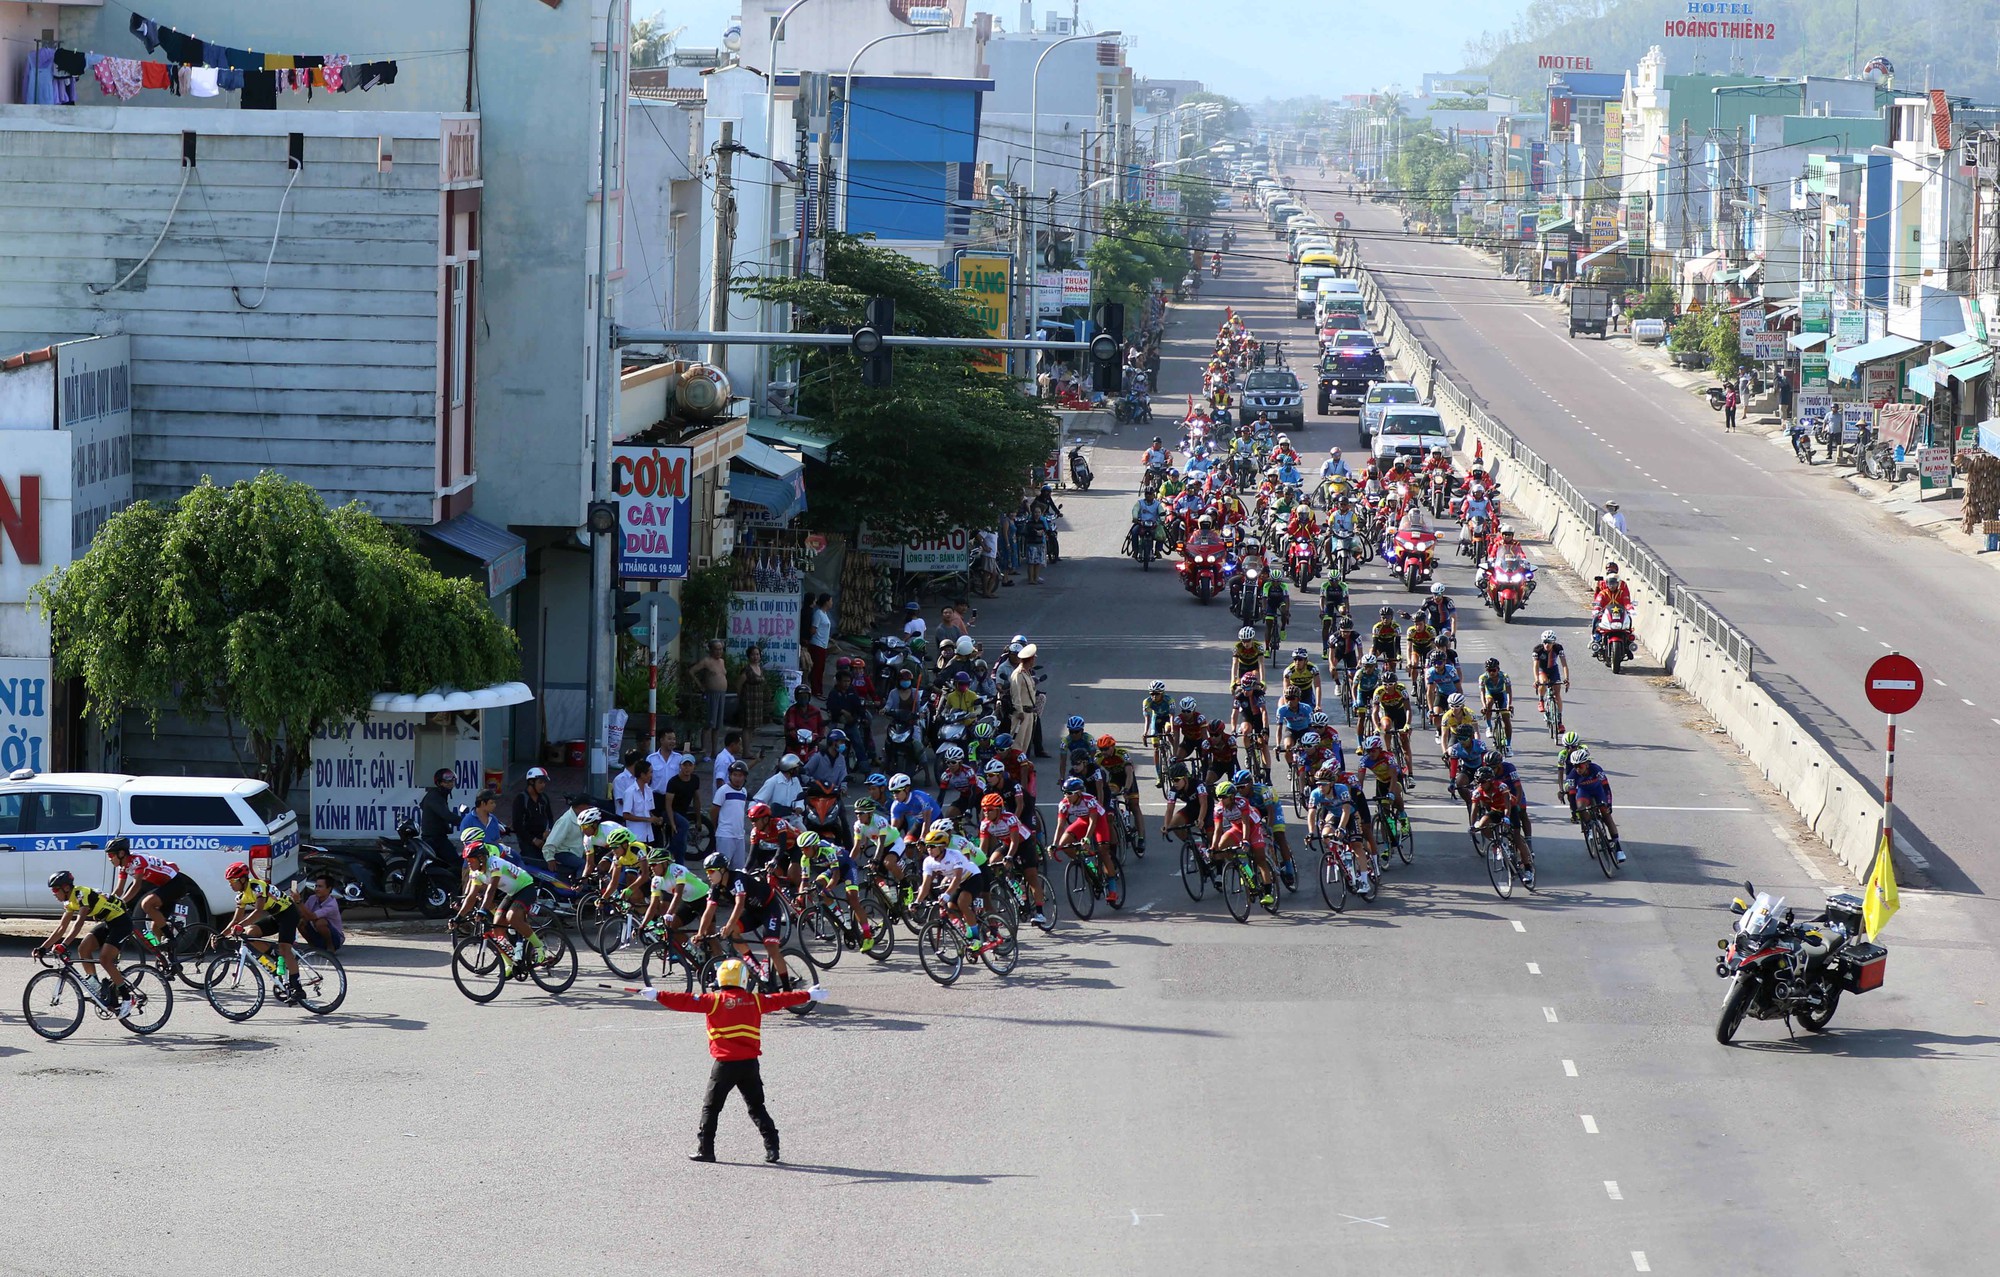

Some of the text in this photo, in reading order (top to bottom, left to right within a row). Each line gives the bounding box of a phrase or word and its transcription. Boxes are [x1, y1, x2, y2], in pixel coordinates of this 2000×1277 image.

[1688, 2, 1753, 14] HOTEL
[1665, 16, 1717, 37] HOÀNG
[1721, 18, 1763, 39] THIÊN
[1538, 55, 1593, 70] MOTEL
[963, 265, 1005, 294] XĂNG
[1741, 310, 1763, 319] HONDA
[1755, 342, 1770, 358] BÚN
[1870, 370, 1883, 379] THANH
[64, 357, 80, 425] MẮT
[80, 362, 96, 420] KÍNH
[615, 448, 687, 498] CƠM
[627, 502, 671, 526] CÂY
[626, 528, 669, 554] DỪA
[649, 563, 657, 572] QL
[660, 564, 667, 572] 19
[668, 564, 682, 573] 50M
[732, 613, 795, 640] BA HIỆP
[316, 758, 333, 787] ĐO
[371, 752, 394, 794] CẬN
[454, 760, 478, 795] OẠN
[316, 799, 349, 830] KÍNH
[356, 799, 387, 830] MÁT
[392, 800, 423, 830] THỜ
[35, 835, 220, 851] SÁT IAO THÔNG
